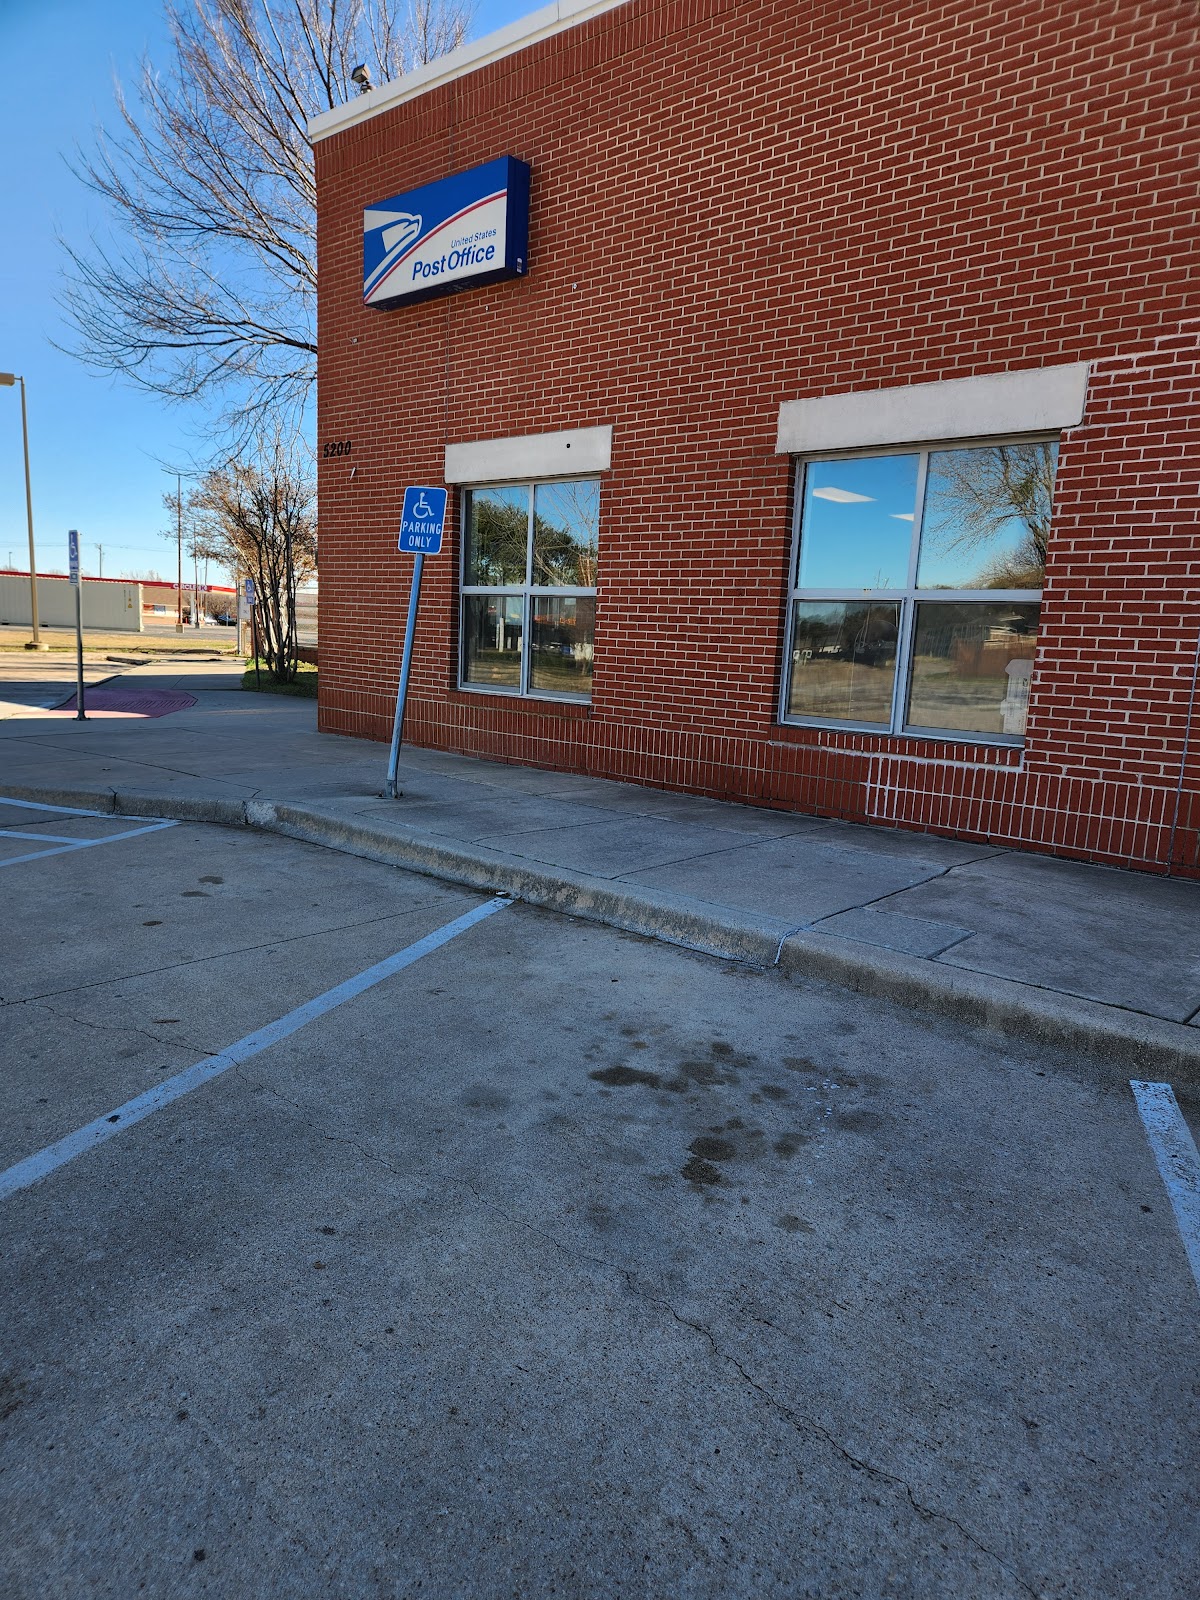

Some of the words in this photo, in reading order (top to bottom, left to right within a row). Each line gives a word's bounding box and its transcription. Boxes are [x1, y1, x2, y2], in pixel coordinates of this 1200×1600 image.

[450, 233, 474, 248] United
[474, 228, 497, 243] States
[412, 254, 446, 280] Post
[447, 244, 495, 270] Office
[323, 440, 352, 458] 5200
[402, 520, 441, 534] PARKING
[408, 535, 432, 548] ONLY
[173, 583, 198, 591] CRCLE
